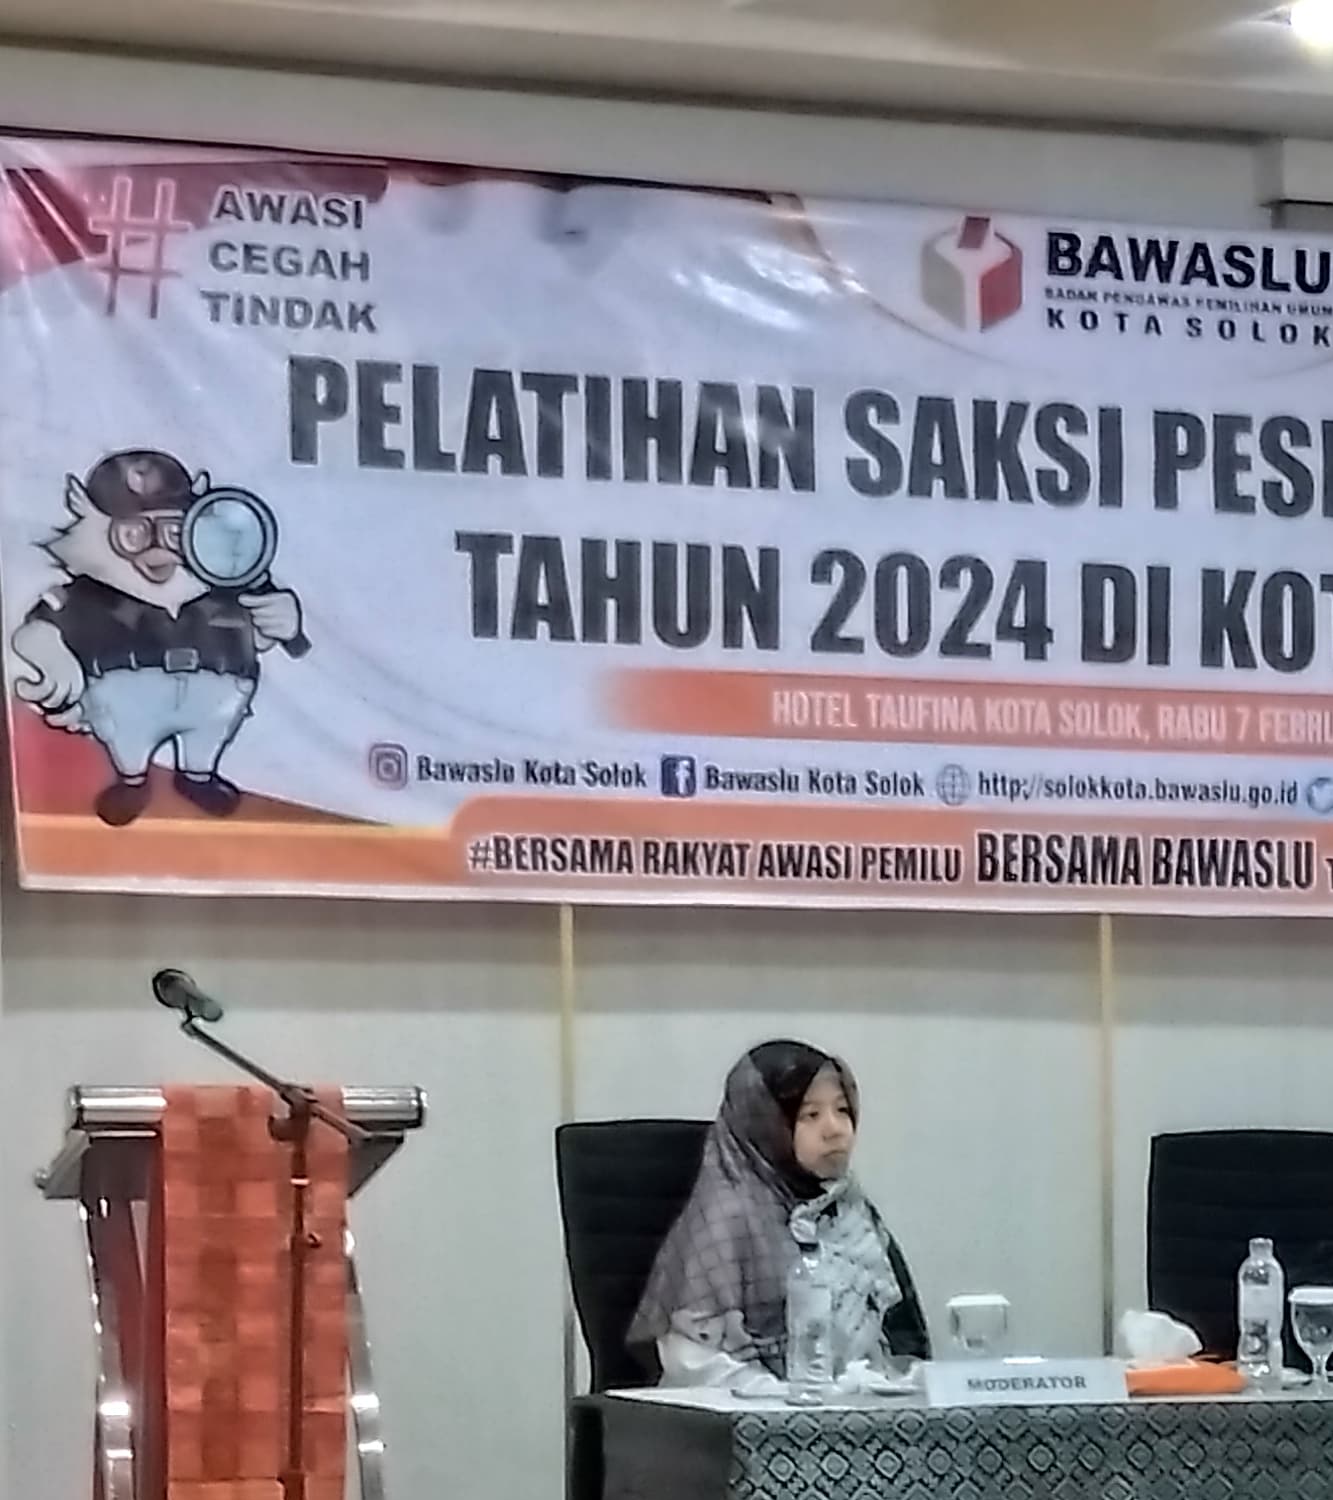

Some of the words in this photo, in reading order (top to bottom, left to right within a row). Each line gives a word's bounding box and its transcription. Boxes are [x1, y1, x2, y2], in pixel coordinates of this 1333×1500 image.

[213, 188, 365, 230] AWASI
[209, 241, 371, 283] CEGAH
[1047, 232, 1331, 293] BAWASLU
[200, 291, 379, 335] TINDAK
[1047, 308, 1162, 336] KOTA
[1186, 317, 1330, 347] SOLOK
[286, 354, 815, 491] PELATIHAN
[843, 389, 1124, 509] SAKSI
[454, 530, 780, 651] TAHUN
[810, 548, 1055, 661] 2024
[1081, 562, 1171, 667] DI
[772, 692, 858, 729] HOTEL
[866, 696, 978, 734] TAUFINA
[985, 699, 1051, 735] KOTA
[1059, 704, 1150, 743] SOLOK,
[1159, 708, 1226, 742] RABU
[1236, 710, 1250, 741] 7
[416, 755, 516, 785] Bawaslu
[523, 759, 577, 786] Kota
[581, 761, 648, 788] Solok
[703, 767, 800, 793] Bawaslu
[808, 768, 857, 796] Kota
[865, 771, 925, 798] Solok
[978, 771, 1299, 808] http://solokkota.bawaslu.go.id
[468, 836, 635, 875] #BERSAMA
[642, 840, 753, 877] RAKYAT
[757, 844, 853, 881] AWASI
[861, 846, 962, 882] PEMILU
[977, 831, 1144, 887] BERSAMA
[1152, 837, 1316, 890] BAWASLU
[966, 1375, 1087, 1391] MODERATOR
